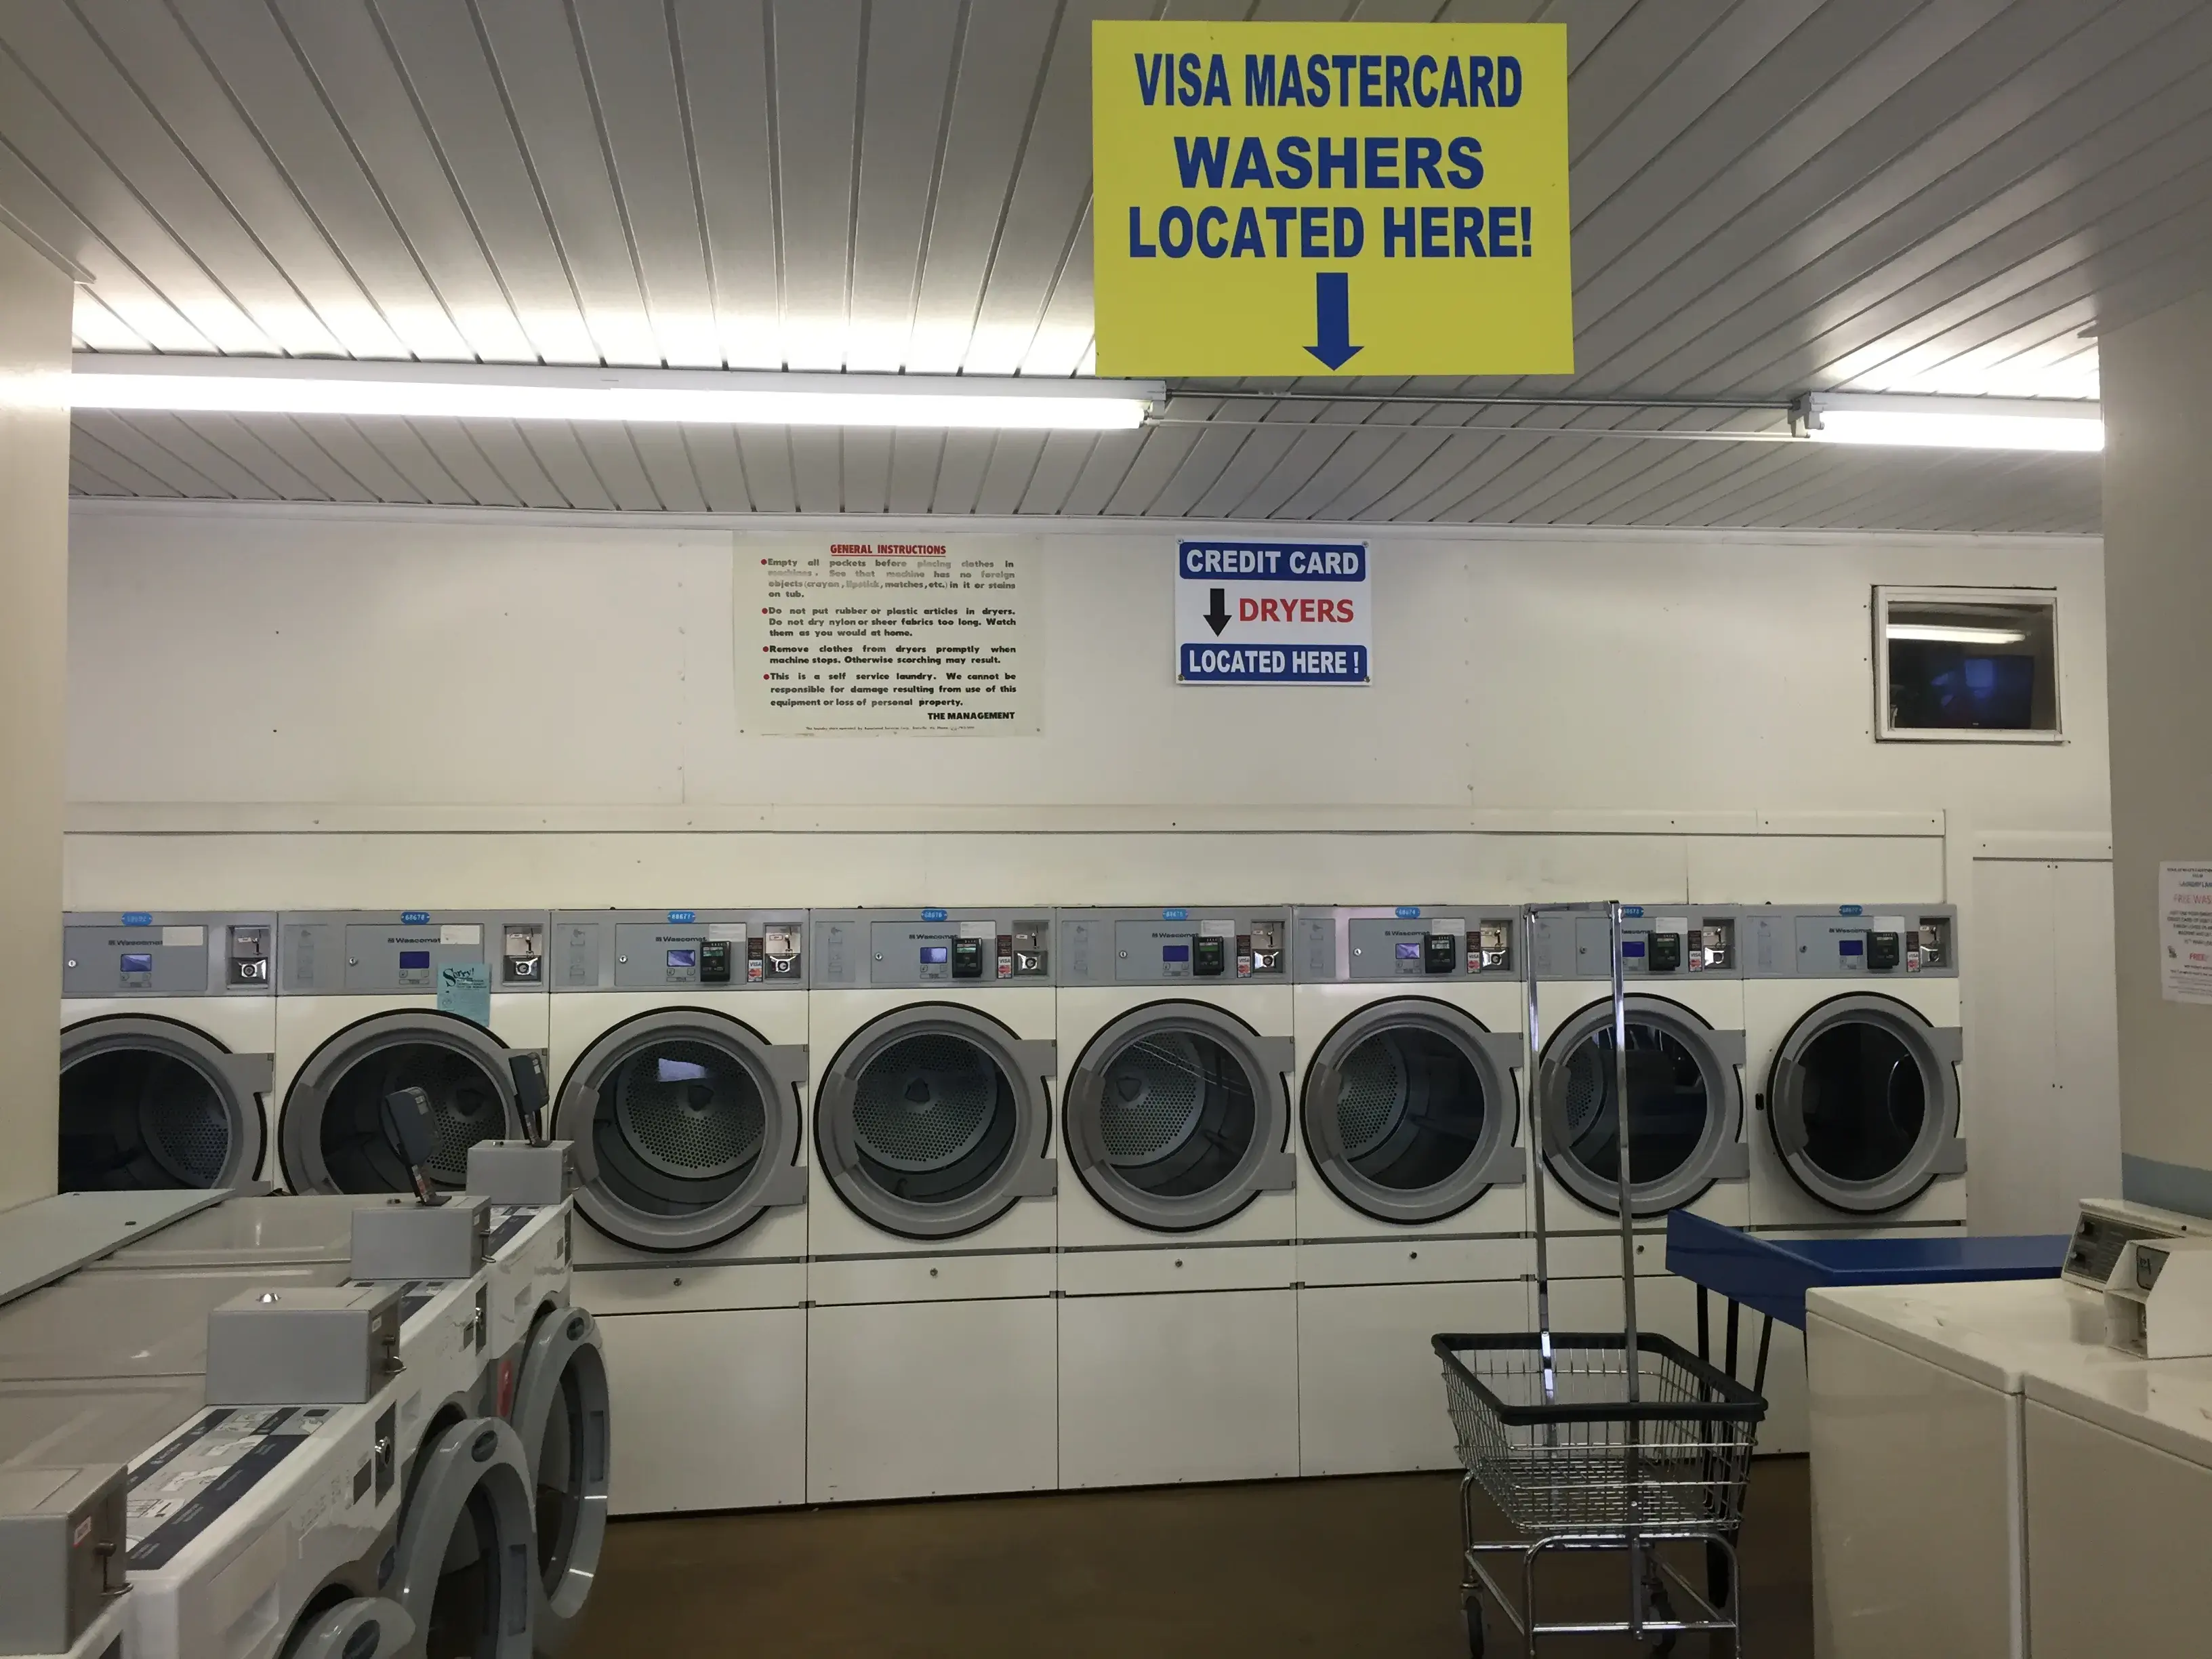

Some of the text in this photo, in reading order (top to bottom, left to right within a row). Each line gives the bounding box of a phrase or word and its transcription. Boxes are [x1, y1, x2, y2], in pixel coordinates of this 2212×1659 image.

[1134, 52, 1521, 108] VISA MASTERCARD
[1173, 136, 1483, 189] WASHERS
[1130, 205, 1532, 258] LOCATED HERE!
[830, 545, 946, 554] GENERAL INSTRUCTIONS
[768, 558, 798, 567] Empty
[830, 559, 865, 567] pockets
[918, 560, 951, 569] placing
[1187, 549, 1359, 575] CREDIT CARD
[981, 571, 1015, 579] foreign
[887, 608, 918, 616] plastic
[1240, 598, 1354, 622] DRYERS
[958, 618, 981, 627] long.
[896, 646, 926, 654] dryers
[936, 646, 980, 654] promptly
[897, 657, 941, 665] scorching
[1189, 649, 1285, 673] LOCATED
[851, 686, 888, 694] damage
[893, 686, 934, 694] resulting
[771, 699, 821, 707] equipment
[872, 699, 913, 708] personal
[919, 699, 963, 707] property.
